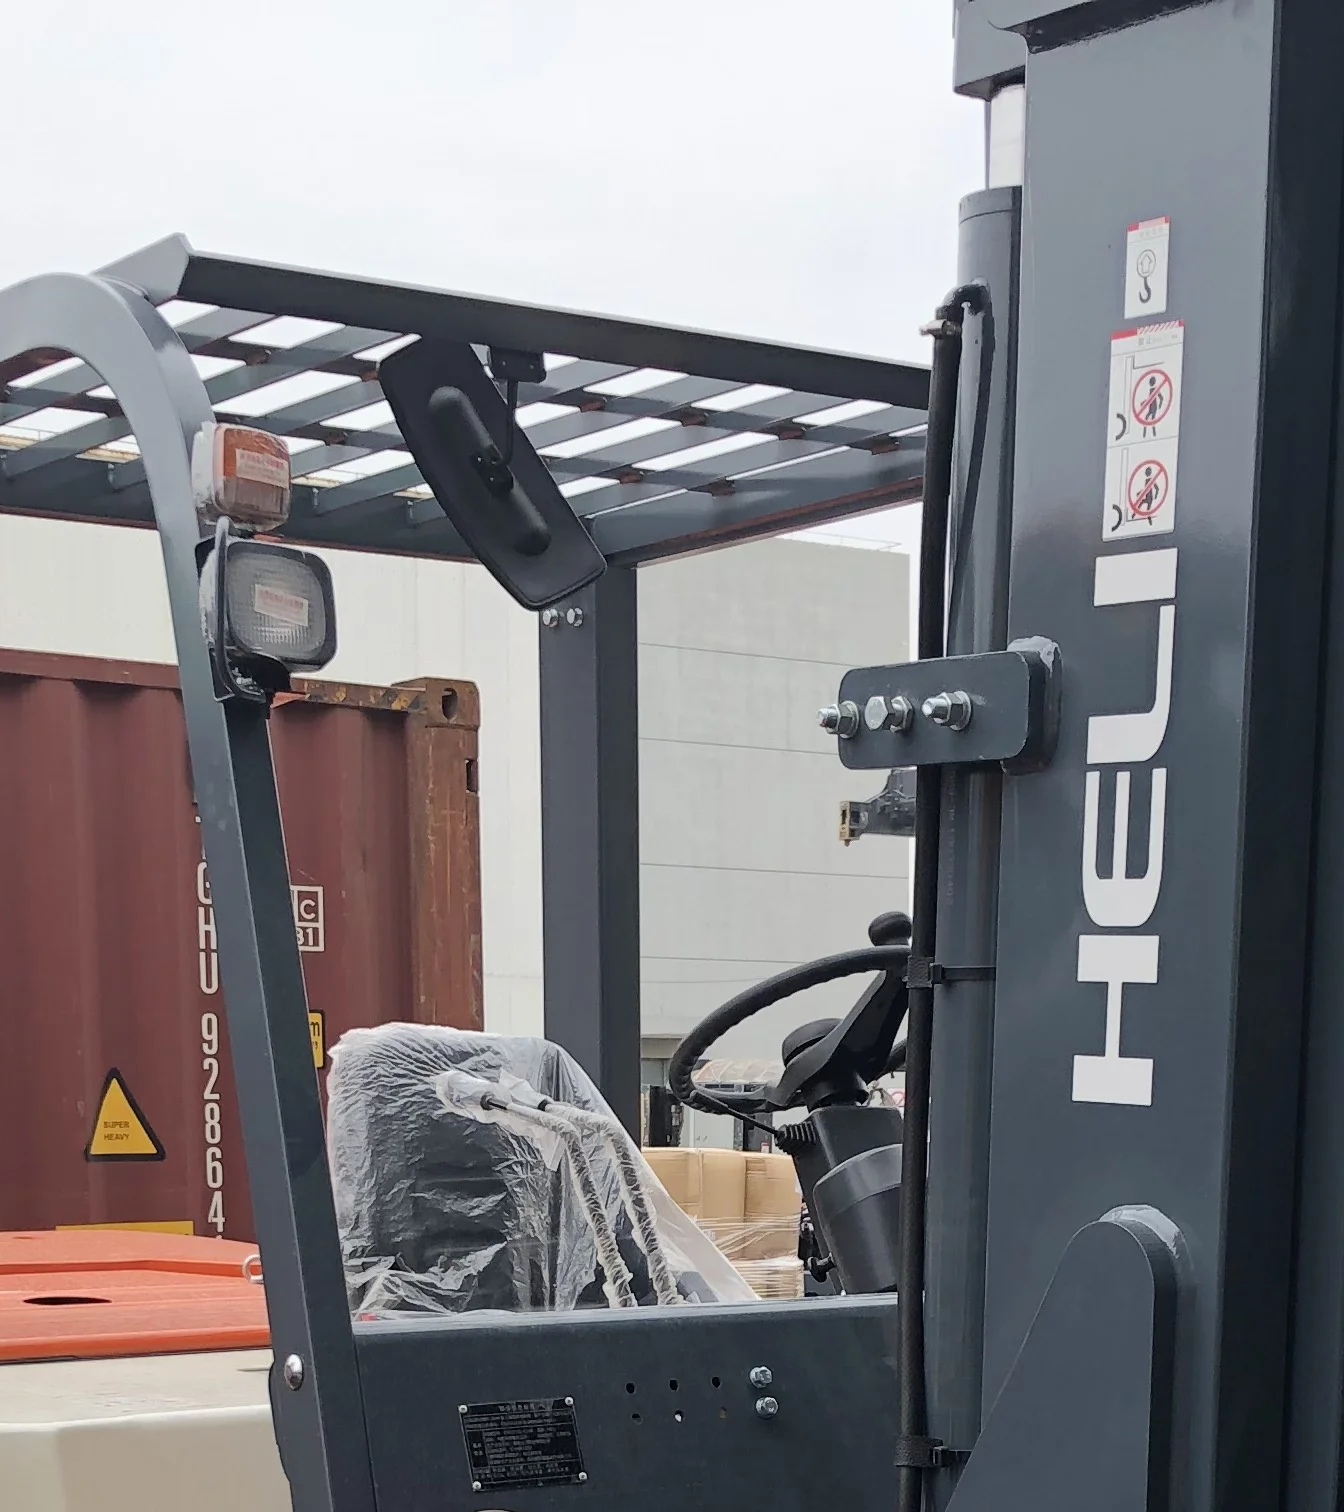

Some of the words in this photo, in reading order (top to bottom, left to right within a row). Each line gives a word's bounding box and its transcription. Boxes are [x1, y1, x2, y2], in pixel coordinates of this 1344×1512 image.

[1072, 547, 1178, 1106] HELI
[103, 1121, 130, 1129] SUPER
[103, 1133, 130, 1141] HEAVY
[201, 1013, 226, 1239] 92864
